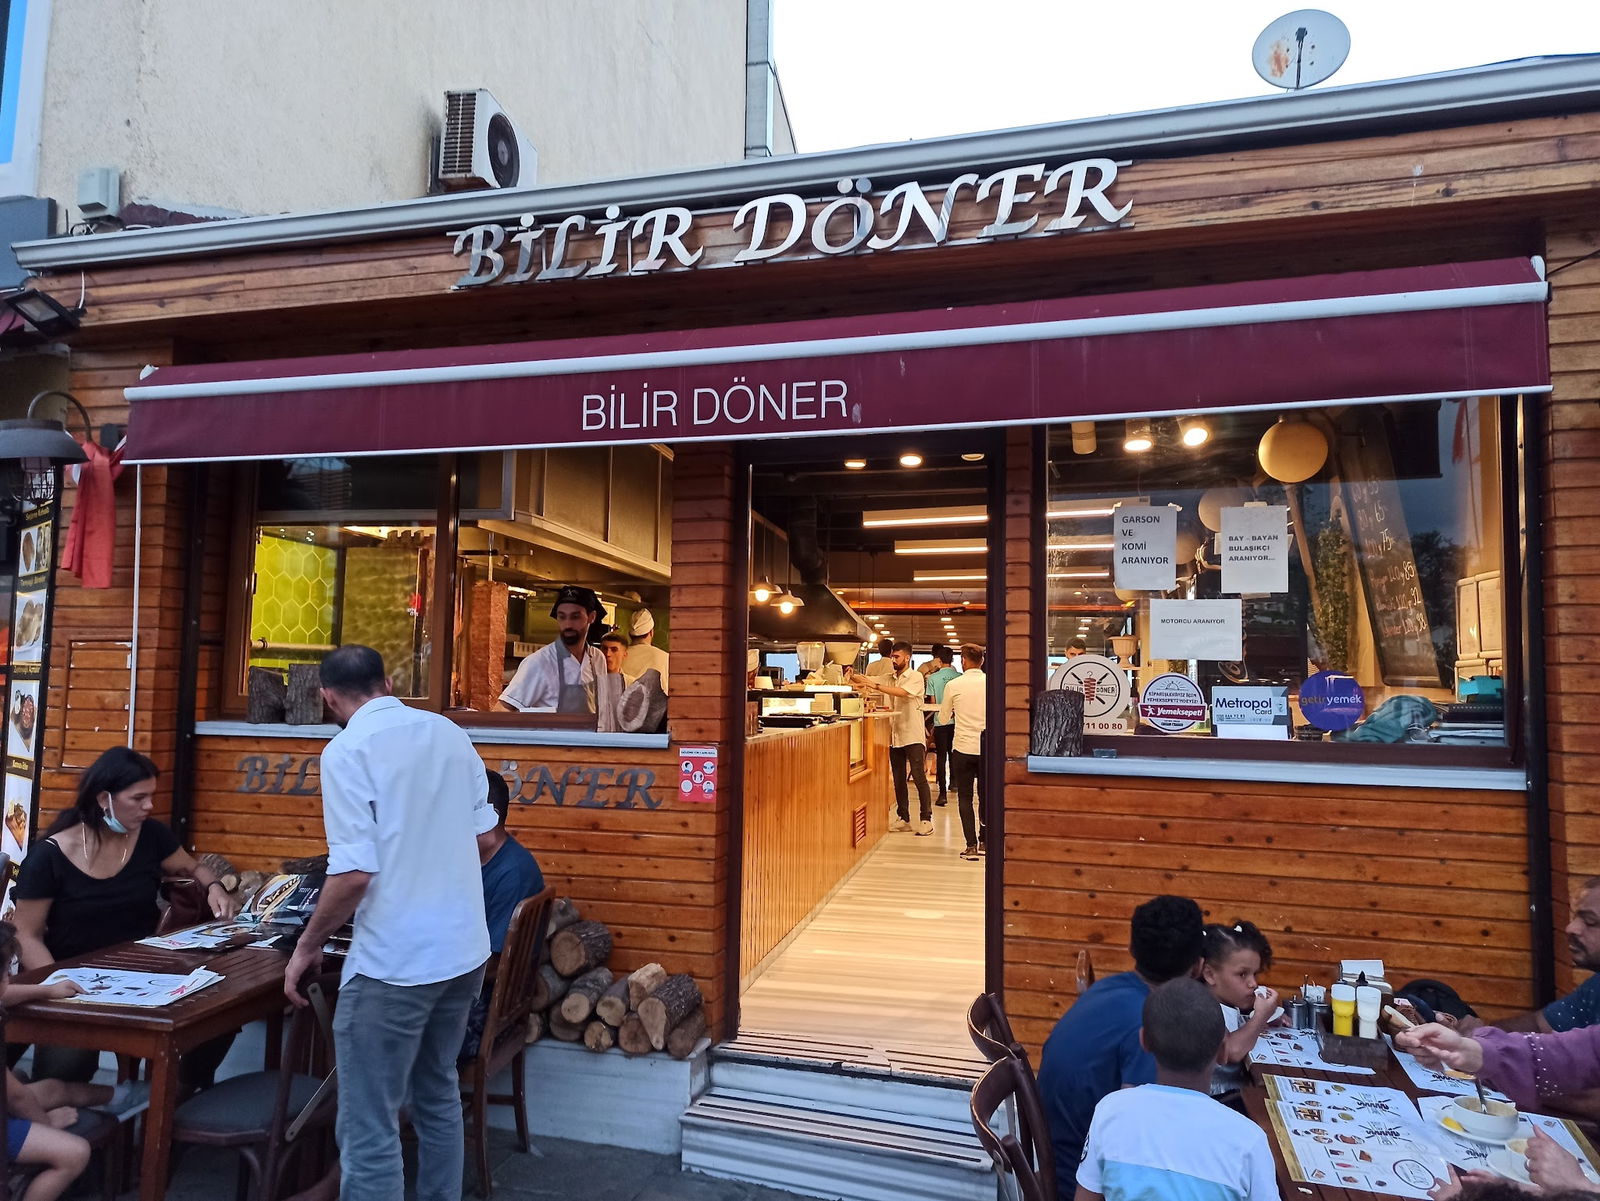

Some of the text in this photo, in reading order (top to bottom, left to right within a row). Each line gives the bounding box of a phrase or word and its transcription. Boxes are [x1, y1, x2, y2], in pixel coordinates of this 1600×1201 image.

[453, 157, 1133, 288] BİLİR DÖNER
[582, 376, 848, 431] BİLİR DÖNER
[1121, 515, 1160, 524] GARSON
[1121, 528, 1134, 537] VE
[1121, 542, 1147, 551] KOMİ
[1121, 556, 1169, 565] ARANIYOR
[1215, 697, 1272, 711] Metropol
[1301, 694, 1362, 706] getiryemek
[1156, 707, 1203, 717] Yemeksepeti
[1098, 722, 1110, 730] 00
[1111, 722, 1123, 730] 80
